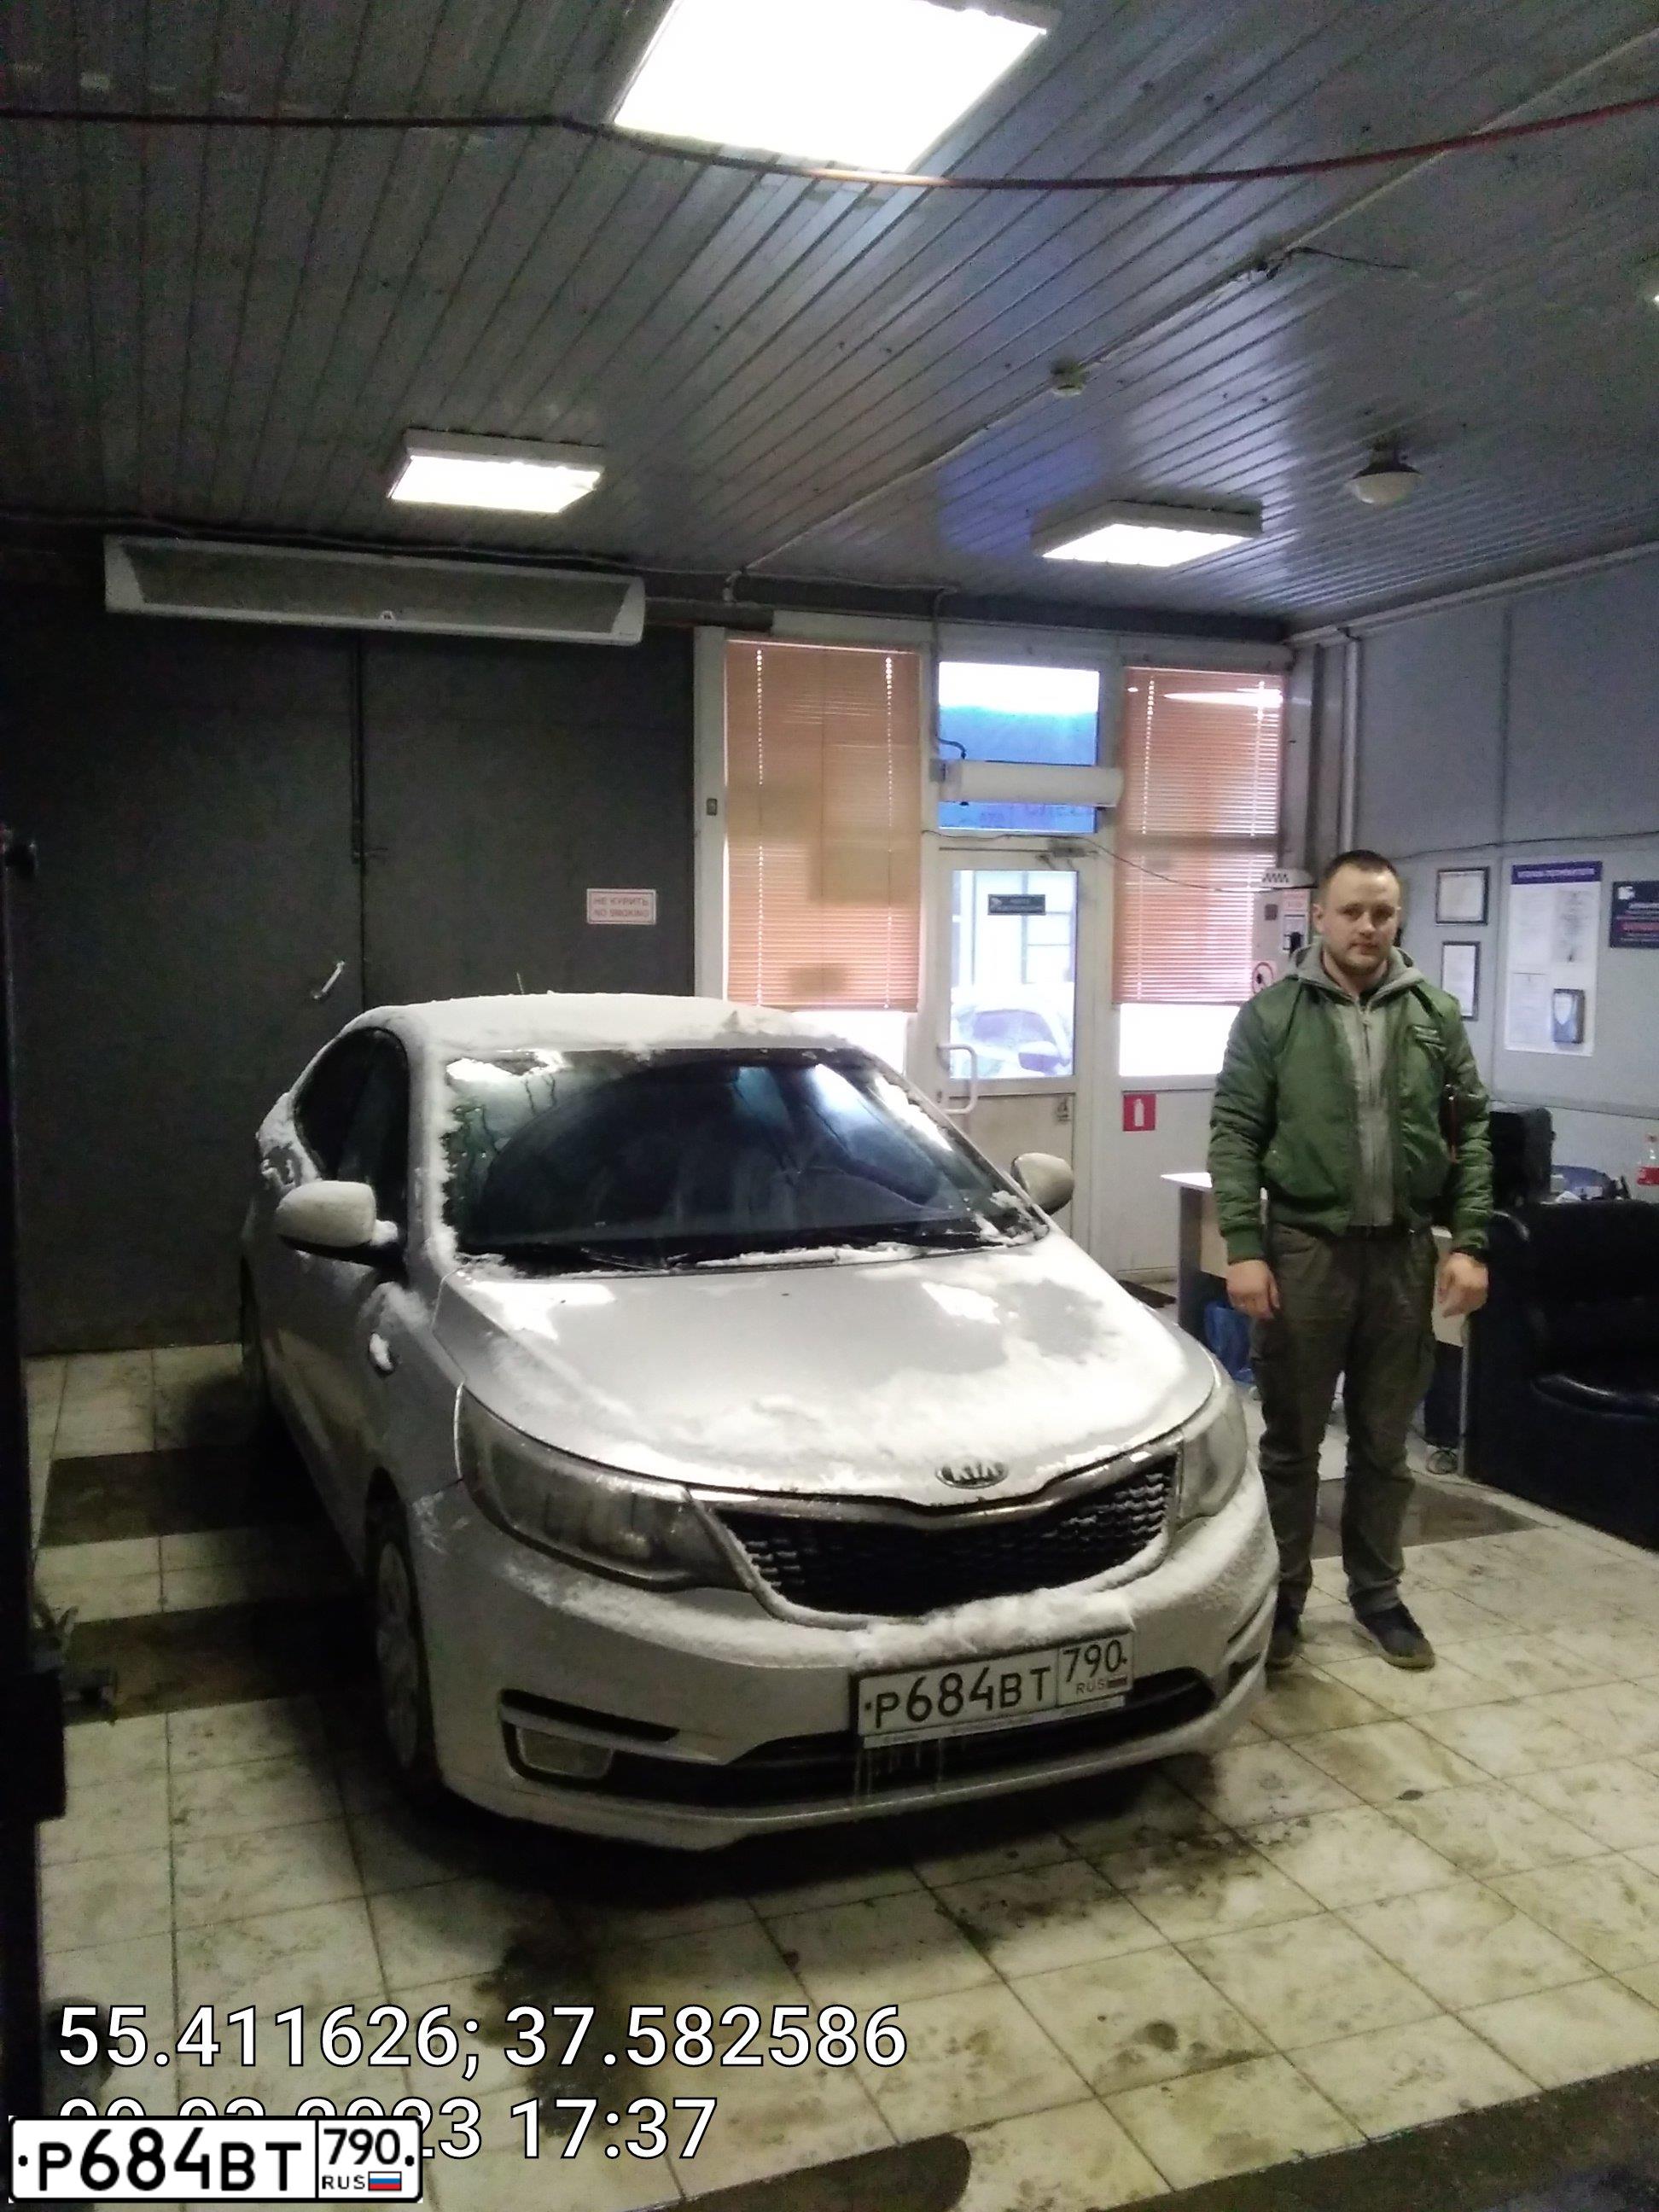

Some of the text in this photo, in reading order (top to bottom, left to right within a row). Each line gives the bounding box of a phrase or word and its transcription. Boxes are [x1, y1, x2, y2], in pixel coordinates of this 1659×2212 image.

[946, 1460, 999, 1481] KIA
[876, 1667, 1051, 1729] Р684ВТ
[1063, 1639, 1123, 1682] 790
[1075, 1679, 1105, 1695] RUS
